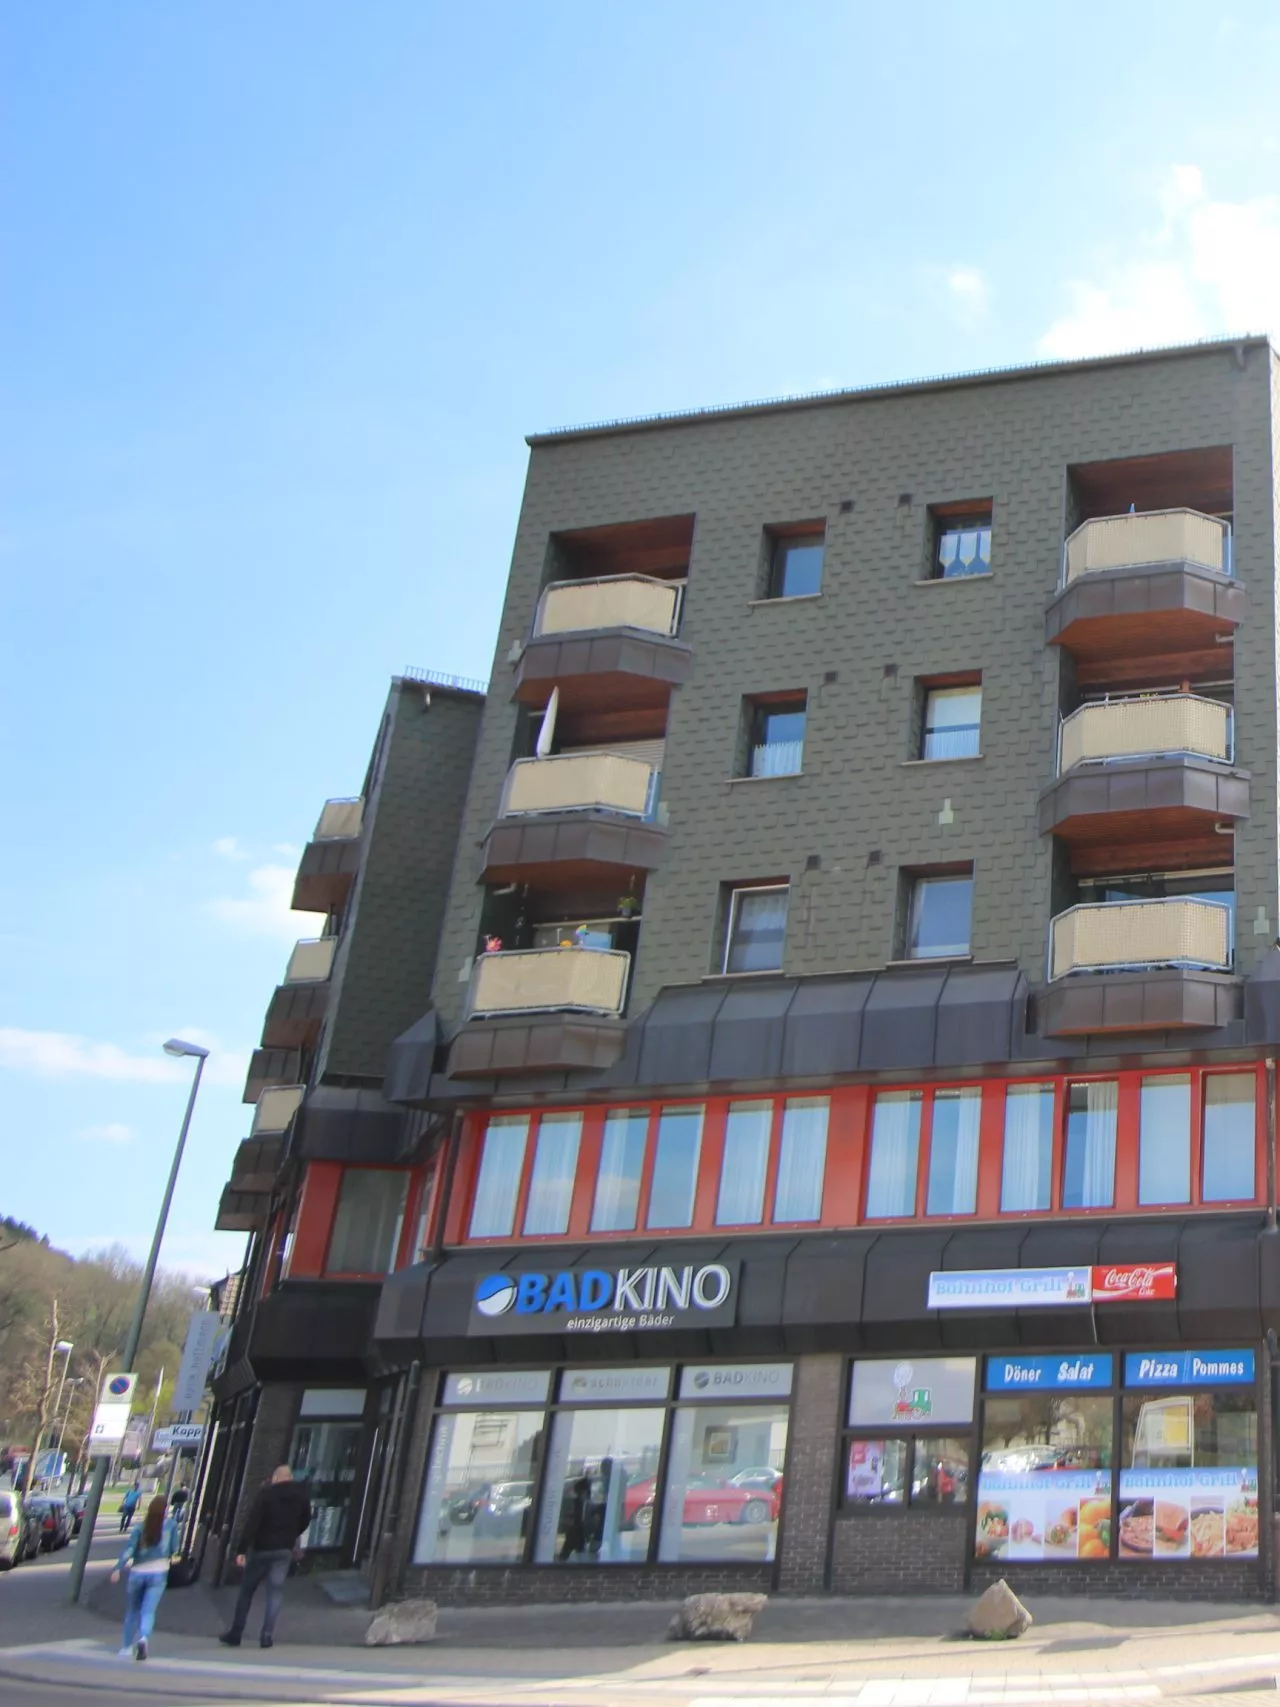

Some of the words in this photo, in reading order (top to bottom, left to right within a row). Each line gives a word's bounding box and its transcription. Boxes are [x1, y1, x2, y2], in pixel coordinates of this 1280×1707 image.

[515, 1263, 731, 1314] BADKINO
[936, 1278, 1014, 1296] Bahnhof
[1020, 1276, 1063, 1293] Grill
[566, 1316, 637, 1332] einzigartige
[639, 1314, 675, 1328] Bäder
[713, 1371, 780, 1385] BADKINO
[1004, 1363, 1042, 1383] Döner
[1057, 1360, 1095, 1382] Salat
[1138, 1359, 1179, 1379] Pizza
[1192, 1357, 1245, 1377] Pommes
[1199, 1471, 1238, 1488] Grill
